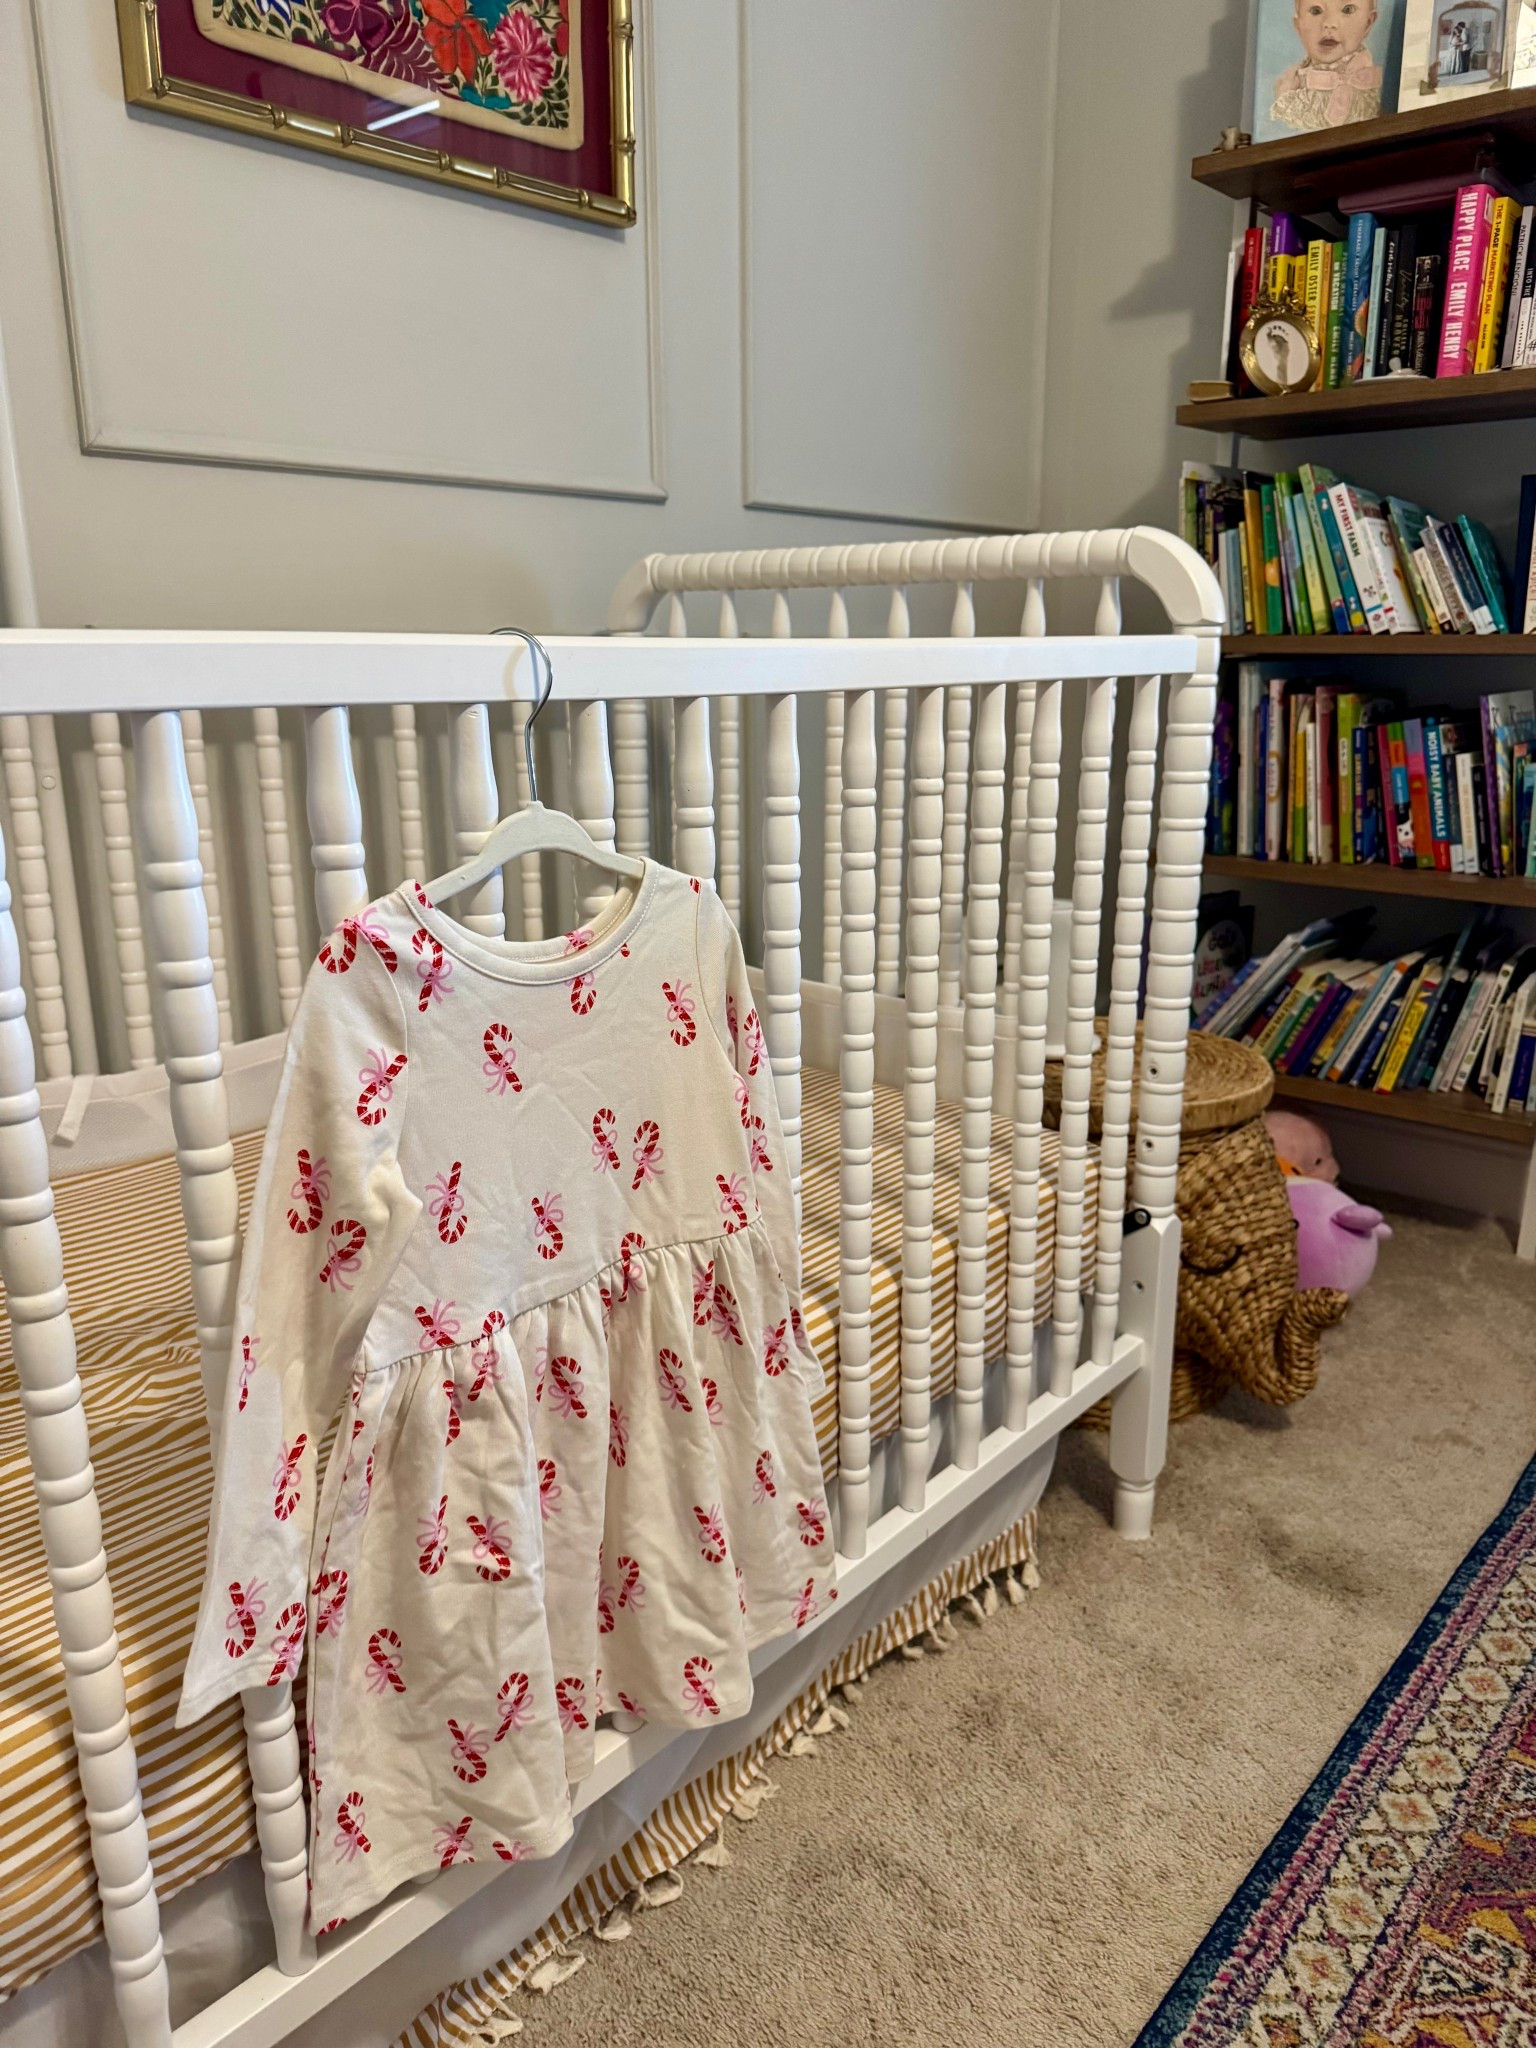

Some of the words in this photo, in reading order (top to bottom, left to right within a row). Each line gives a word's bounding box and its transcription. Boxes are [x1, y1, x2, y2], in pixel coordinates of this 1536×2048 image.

[1458, 192, 1478, 231] HAPPY
[1355, 219, 1363, 256] REMARKABLY
[1493, 221, 1502, 248] 1-PAGE
[1516, 225, 1527, 257] PATRICK
[1309, 246, 1320, 271] EMILY
[1453, 235, 1473, 272] PLACE
[1487, 249, 1498, 293] MARKETING
[1511, 258, 1522, 296] LENCIONI
[1526, 268, 1534, 284] INTO
[1307, 275, 1318, 301] OSTER
[1331, 272, 1340, 310] VACATION
[1351, 280, 1360, 311] CREATURES
[1395, 269, 1413, 311] Verity
[1447, 282, 1468, 317] EMILY
[1523, 285, 1532, 297] THE
[1484, 294, 1493, 315] PLAN
[1331, 326, 1340, 352] EMILY
[1442, 322, 1463, 358] HENRY
[1335, 494, 1346, 508] MY
[1340, 508, 1354, 532] FIRST
[1346, 531, 1361, 557] FARM
[1427, 731, 1439, 761] NOISY
[1430, 763, 1442, 788] BABY
[1432, 790, 1447, 838] ANIMALS
